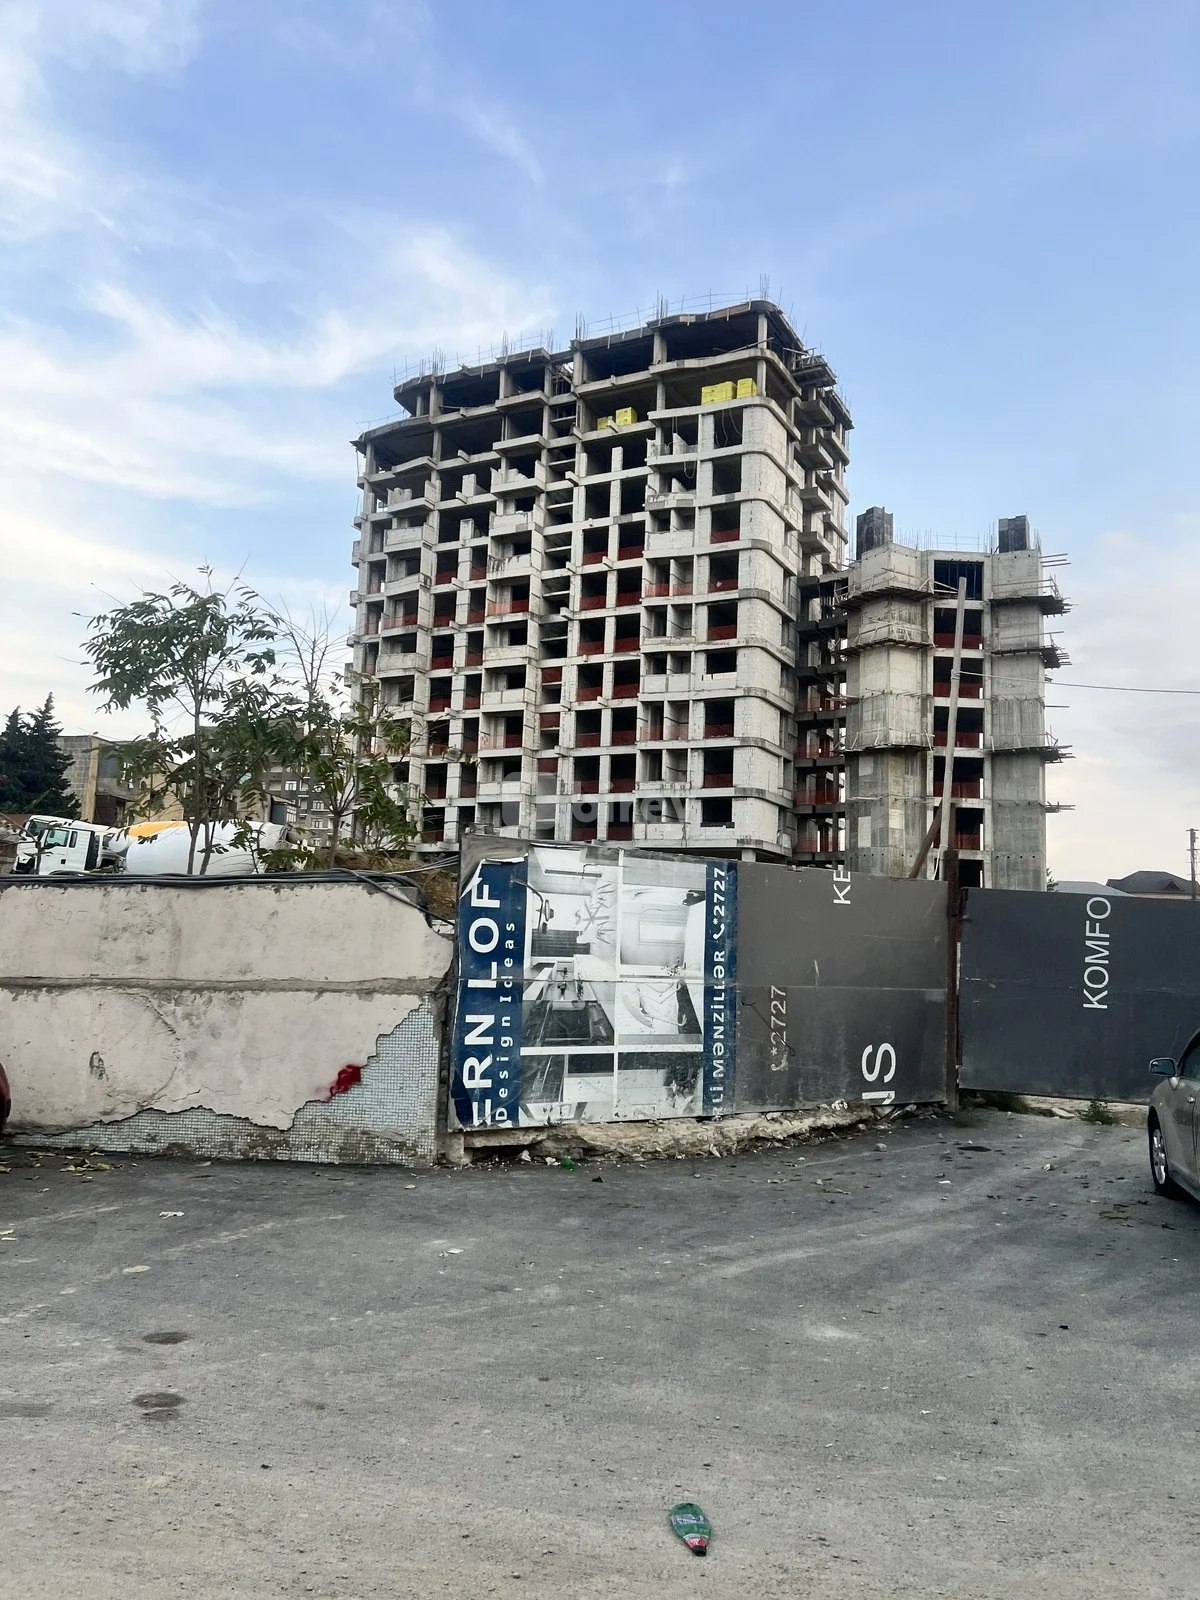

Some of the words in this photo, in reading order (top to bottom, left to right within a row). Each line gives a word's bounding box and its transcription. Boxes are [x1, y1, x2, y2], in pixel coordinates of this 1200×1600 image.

[833, 870, 851, 904] KE
[499, 922, 516, 1003] Ideas
[1083, 896, 1111, 1009] KOMFO
[495, 1016, 513, 1121] Design
